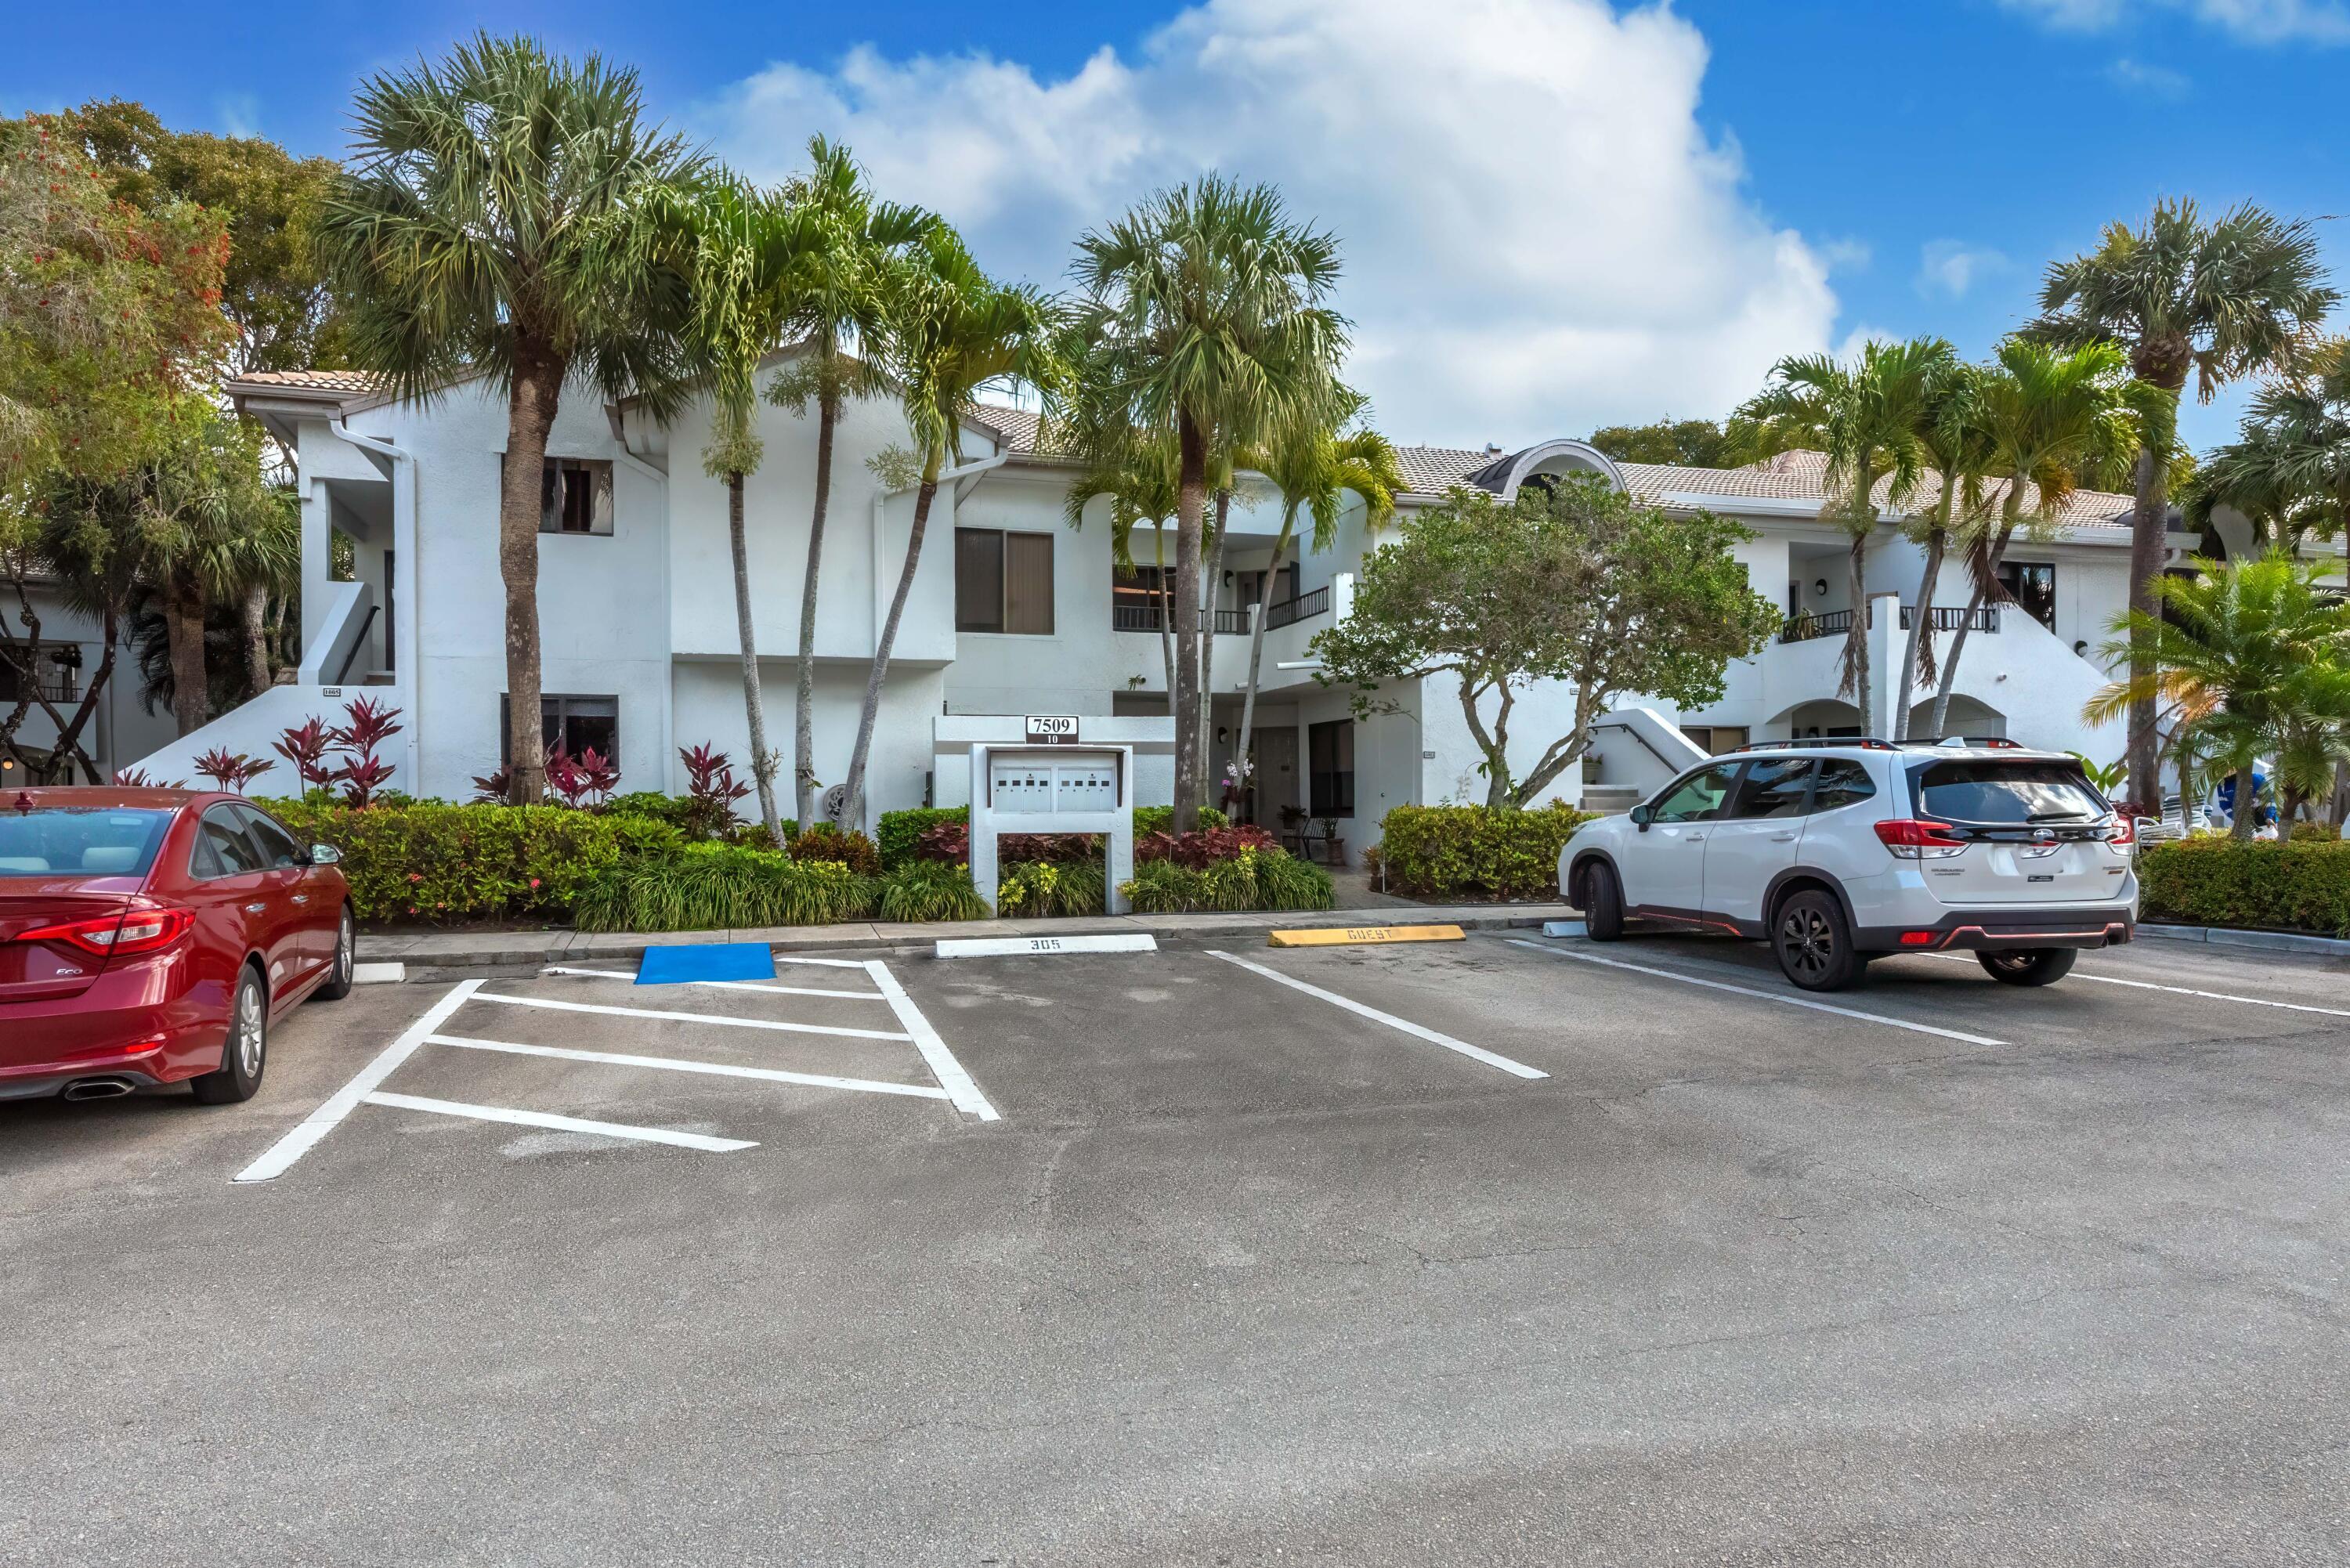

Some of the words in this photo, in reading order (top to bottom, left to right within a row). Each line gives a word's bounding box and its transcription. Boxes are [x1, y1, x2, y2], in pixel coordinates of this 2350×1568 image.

[1033, 718, 1070, 733] 7509
[1047, 735, 1058, 744] 10
[1347, 929, 1392, 940] GUEST
[1030, 939, 1061, 950] 305
